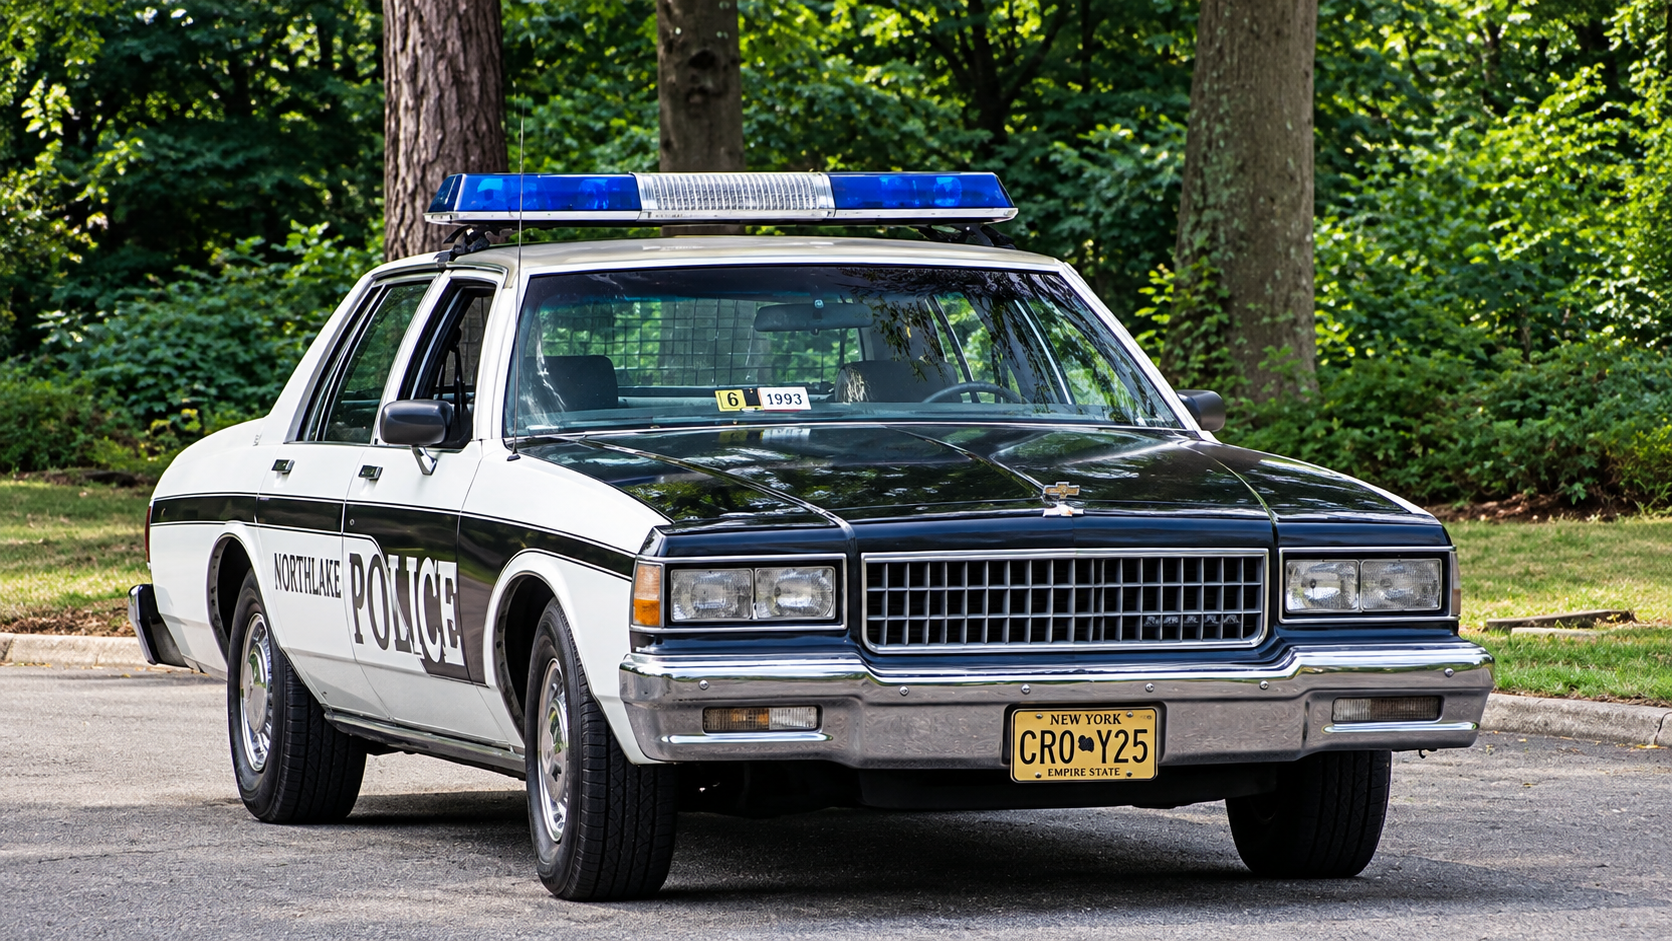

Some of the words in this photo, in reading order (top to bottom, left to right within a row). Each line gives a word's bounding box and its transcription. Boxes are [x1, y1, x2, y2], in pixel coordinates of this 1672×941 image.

[727, 391, 739, 407] 6
[767, 393, 802, 405] 1993
[274, 553, 341, 598] NORTHLAKE
[350, 553, 464, 666] POLICE
[1050, 714, 1081, 725] NEW
[1085, 713, 1121, 725] YORK
[1096, 729, 1148, 763] Y25
[1048, 768, 1086, 777] EMPIRE
[1089, 768, 1120, 776] STATE
